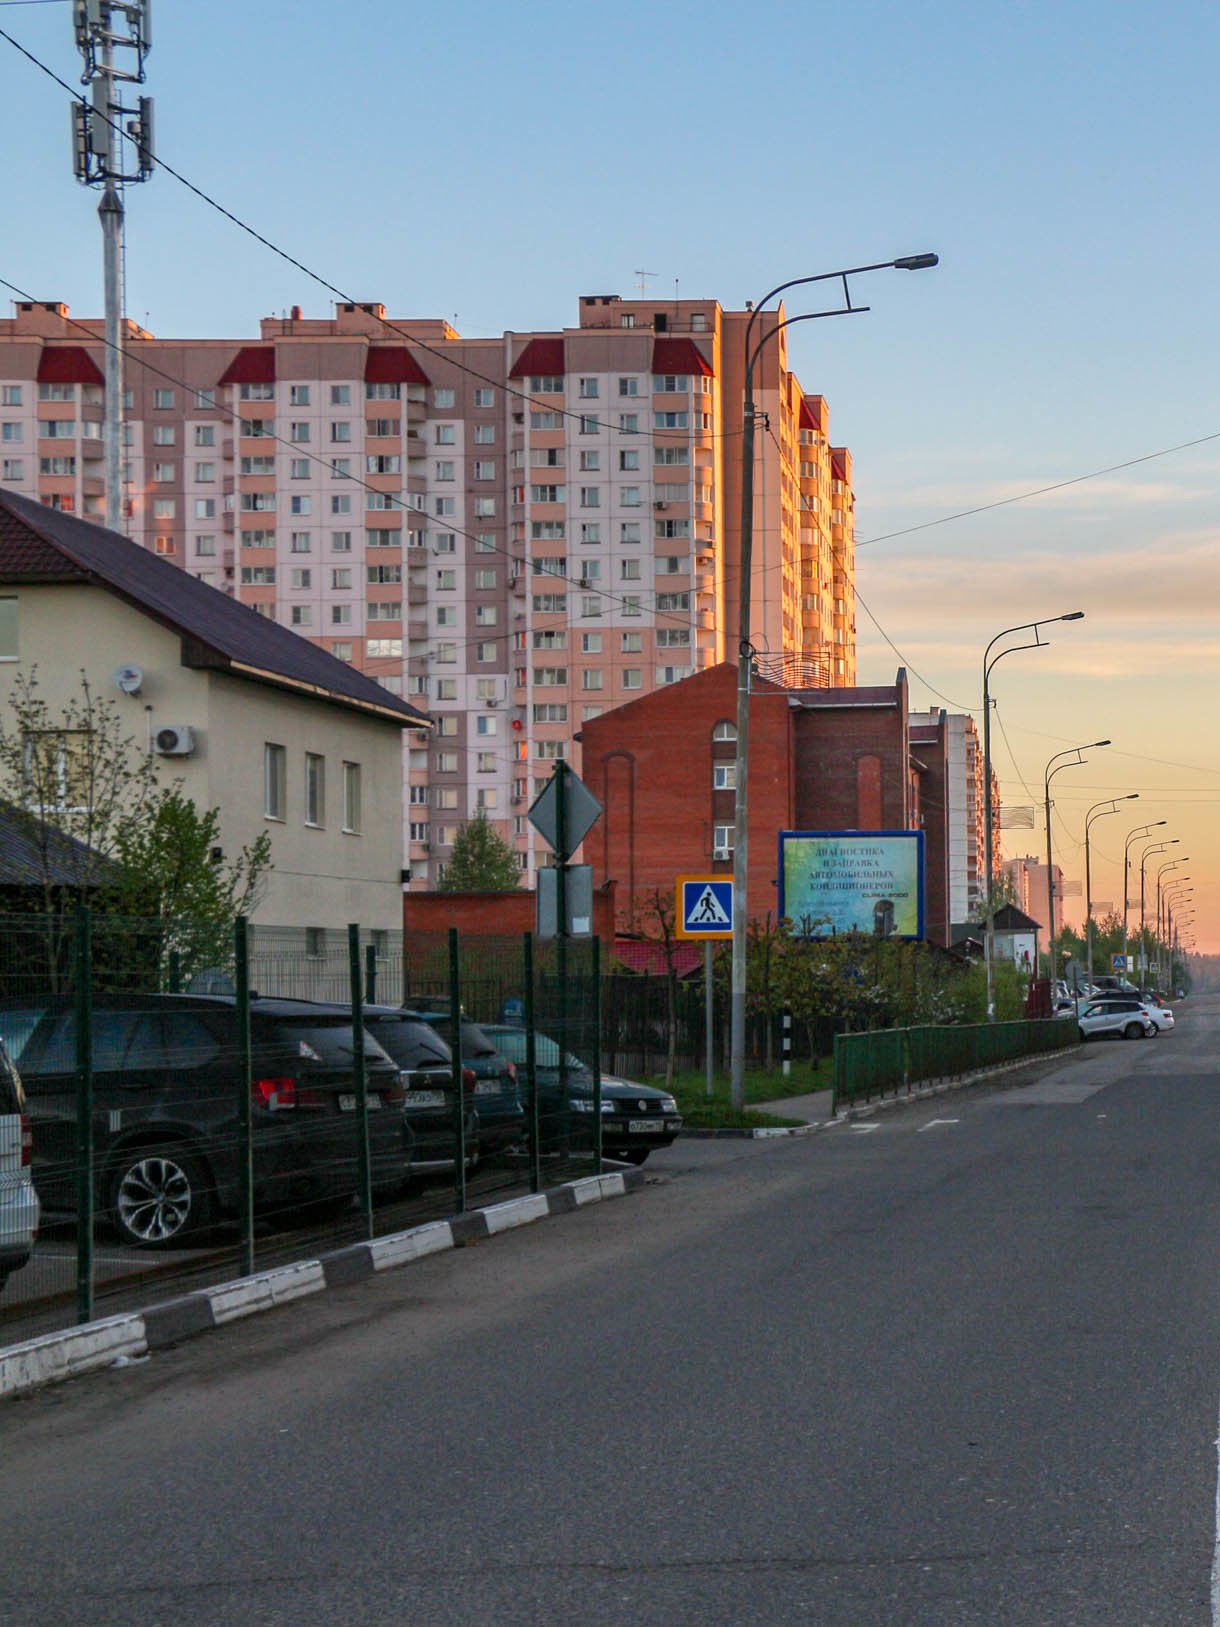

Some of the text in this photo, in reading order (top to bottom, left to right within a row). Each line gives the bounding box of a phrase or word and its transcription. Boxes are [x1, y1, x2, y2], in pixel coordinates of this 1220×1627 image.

[816, 847, 885, 857] ДИАГНОСТИКА
[808, 870, 894, 879] АВТОМОБИЛЬНЫХ
[810, 881, 894, 891] КОНДИЦИОНЕРОВ
